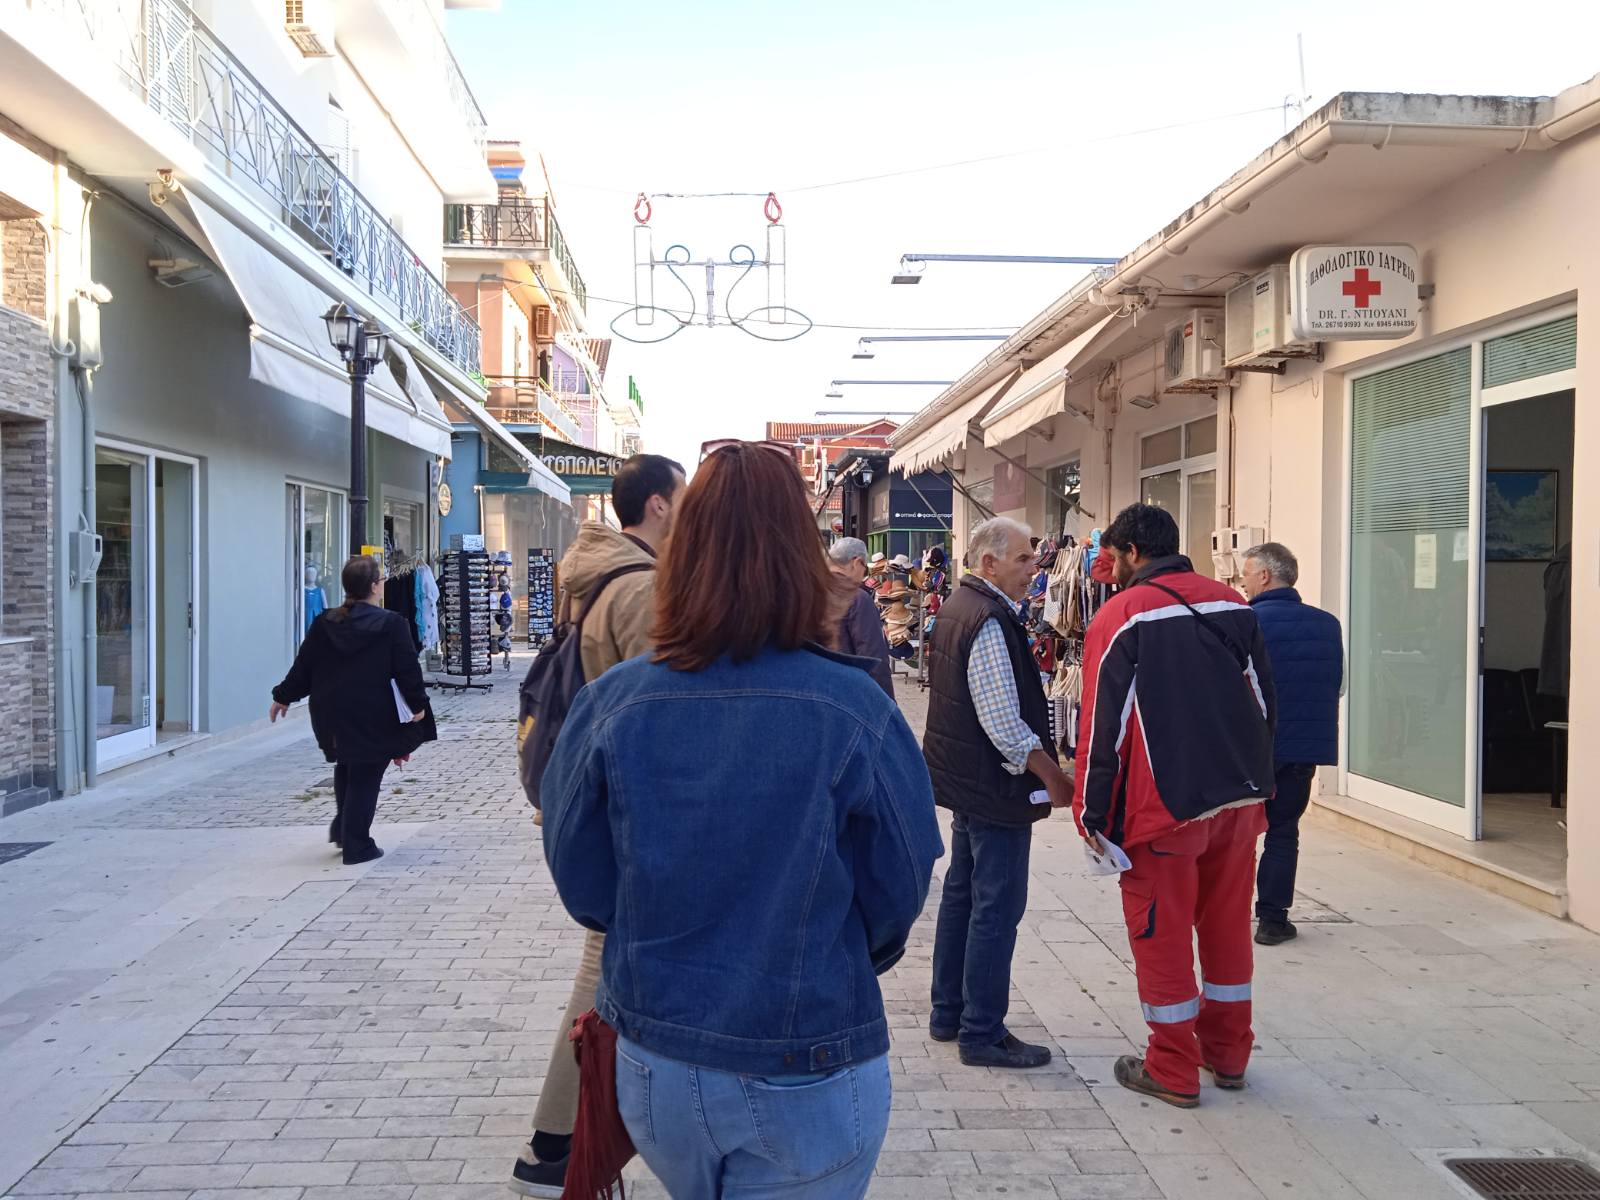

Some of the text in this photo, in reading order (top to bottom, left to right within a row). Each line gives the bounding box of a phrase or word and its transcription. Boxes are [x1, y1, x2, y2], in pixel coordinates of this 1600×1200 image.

[1310, 250, 1415, 286] ΠΑΘΟΛΟΓΙΚΟ ΙΑΤΡΕΙΟ
[1319, 308, 1407, 319] DR. Γ. ΝΤΙΟΥΑΝΙ
